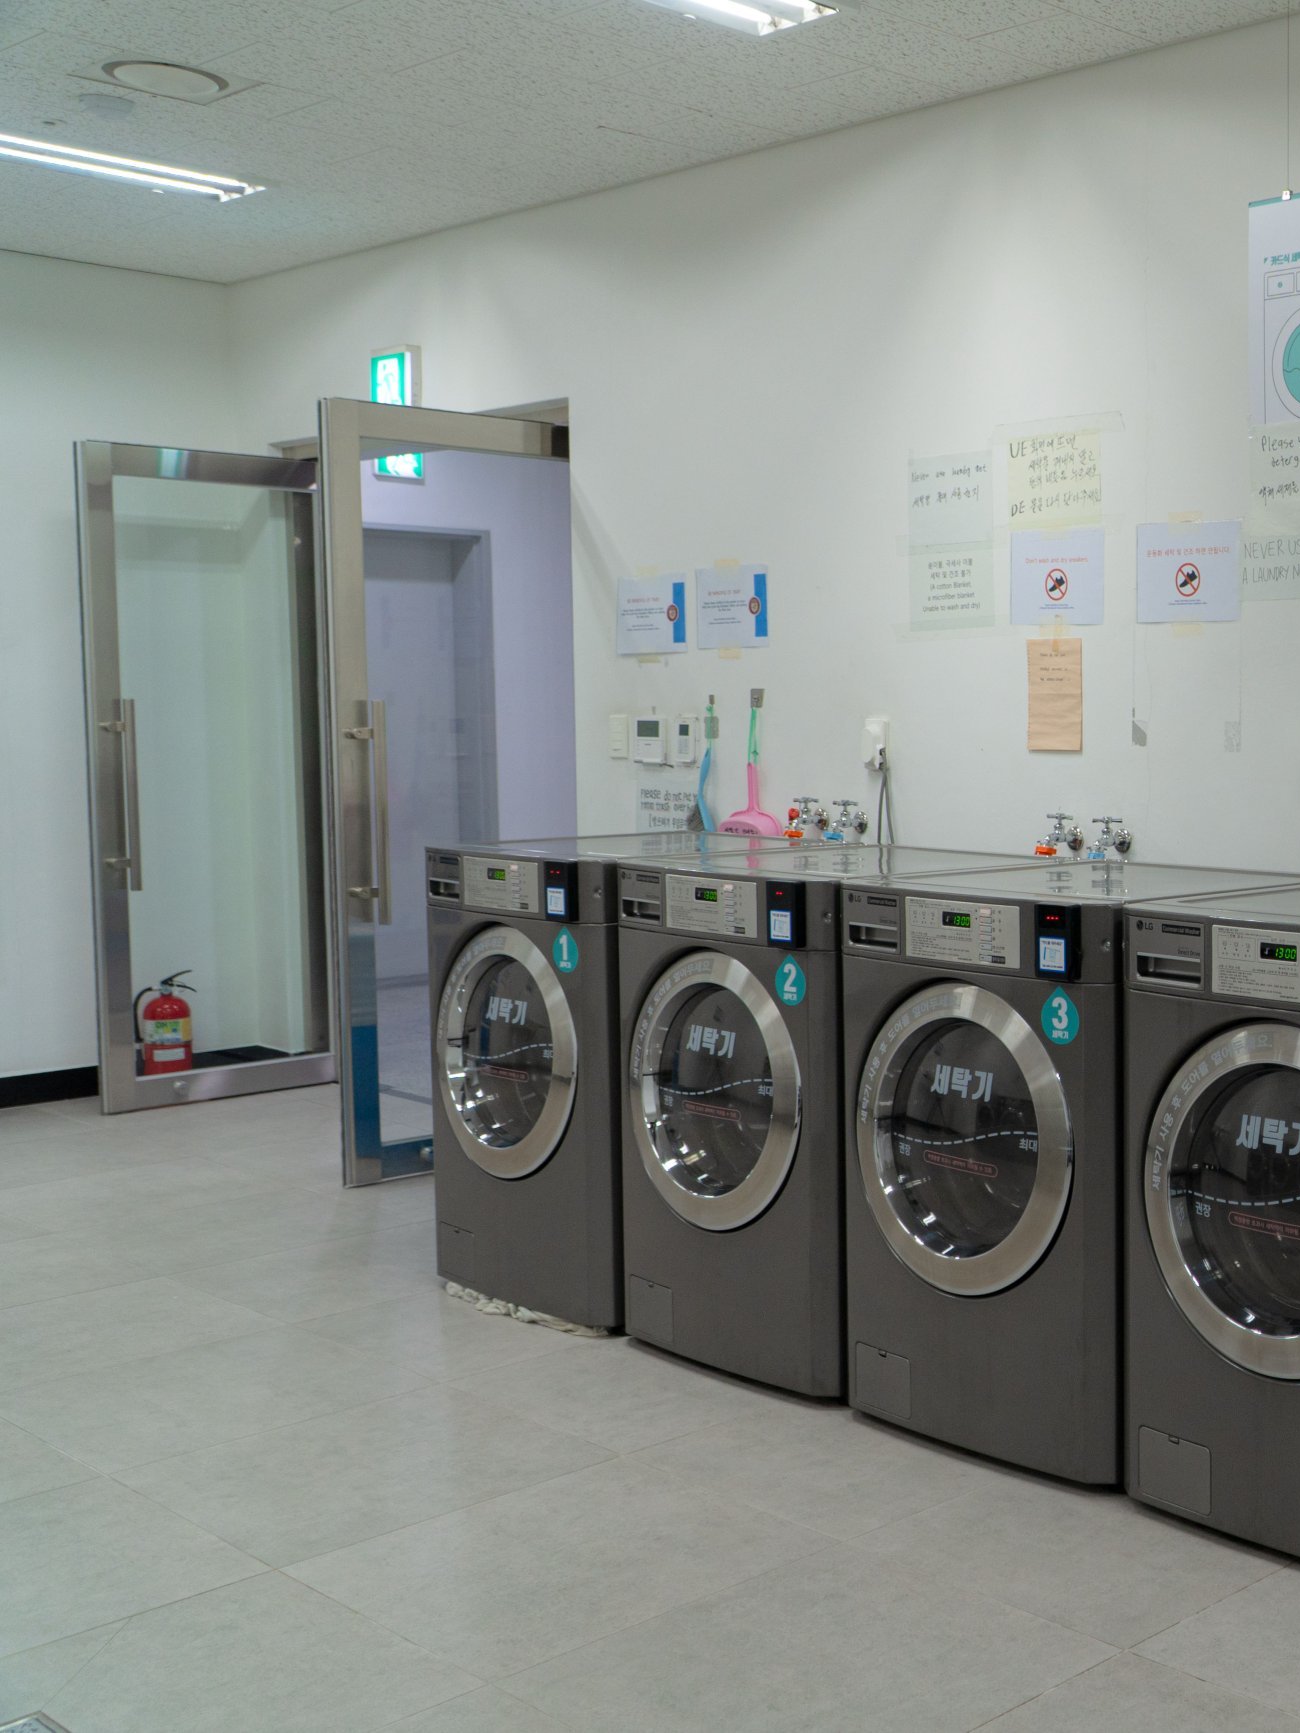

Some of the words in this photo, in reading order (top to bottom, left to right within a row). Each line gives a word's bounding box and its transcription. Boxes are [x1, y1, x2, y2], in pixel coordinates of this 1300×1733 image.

[1009, 440, 1028, 459] UE
[1261, 434, 1294, 452] Please
[1011, 499, 1025, 517] DE
[1243, 540, 1286, 562] NEVER
[1242, 567, 1249, 584] A
[1252, 563, 1289, 583] LAUNDRY
[560, 935, 568, 960] 1
[783, 963, 797, 992] 2
[486, 996, 528, 1026] 세탁기
[1052, 996, 1068, 1029] 3
[686, 1024, 737, 1059] 세탁기
[930, 1063, 994, 1103] 세탁기
[1152, 1146, 1165, 1191] 세탁기
[1159, 1113, 1174, 1142] 사용
[1171, 1096, 1182, 1111] 후
[1181, 1062, 1210, 1096] 도어를
